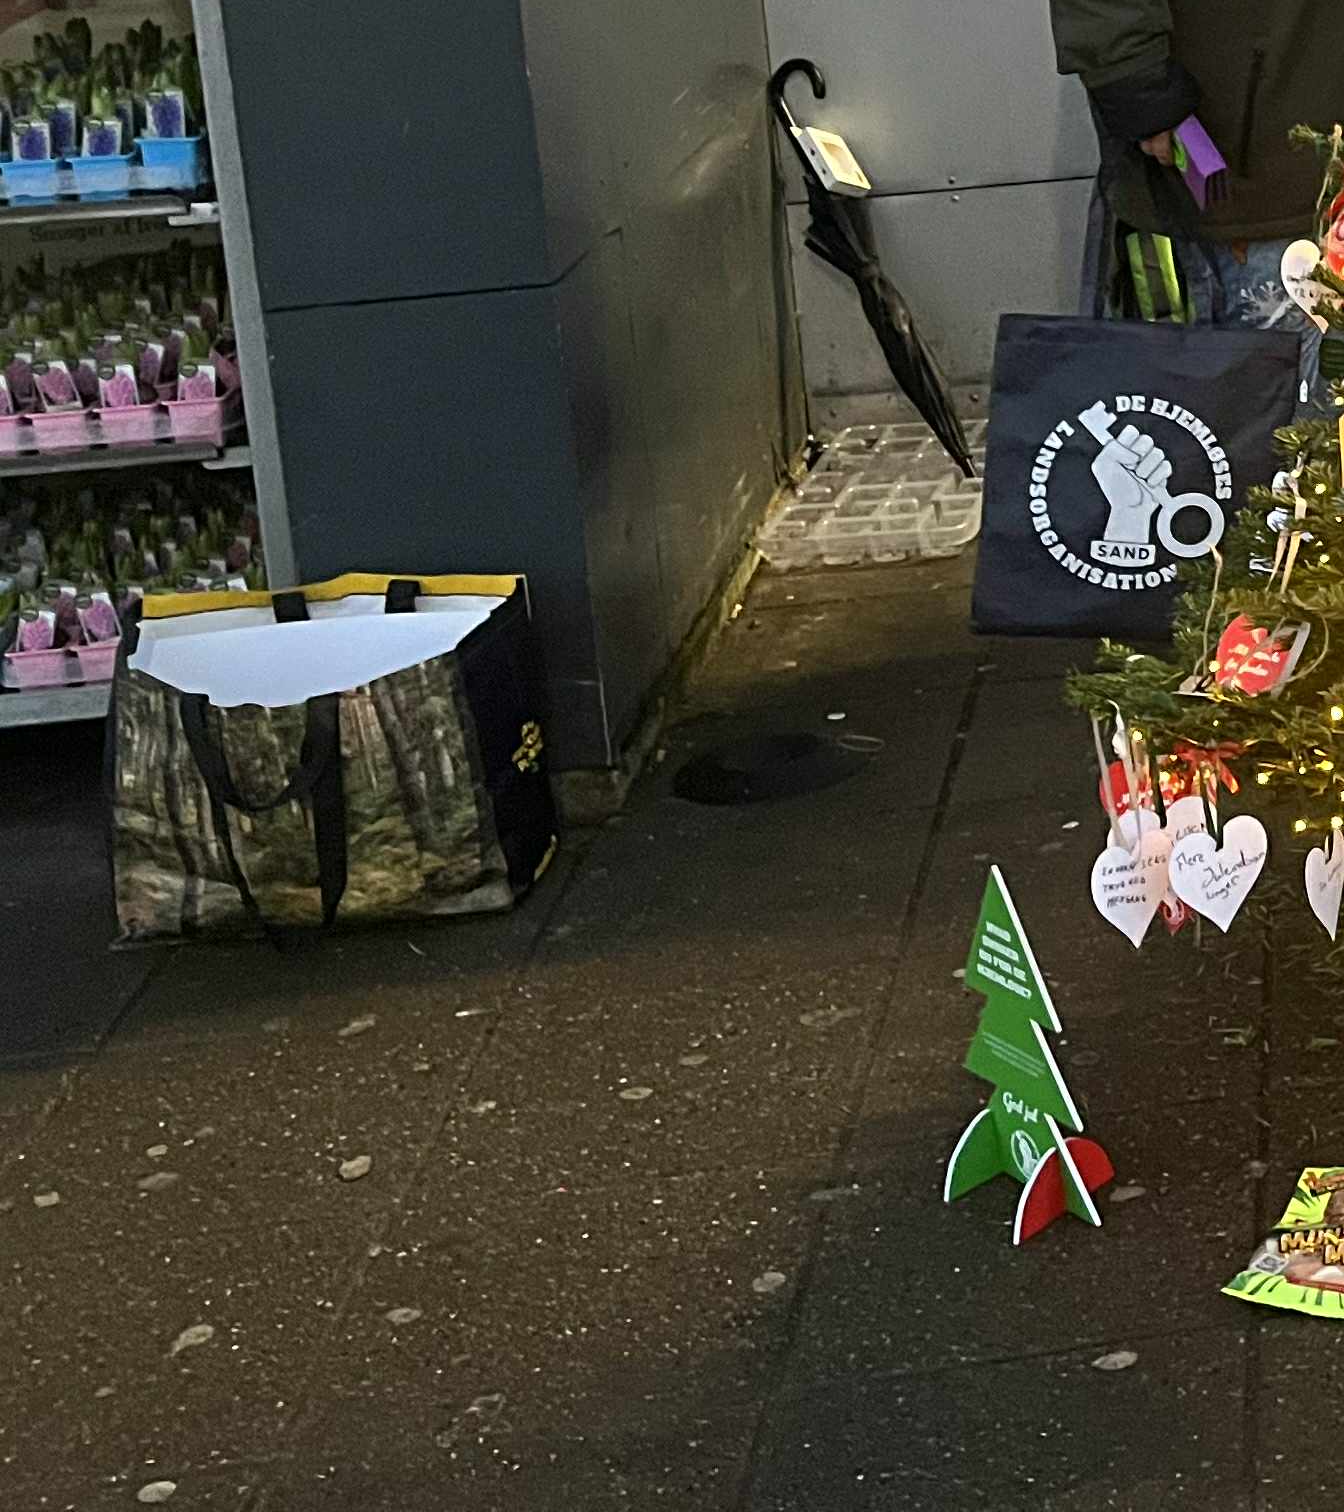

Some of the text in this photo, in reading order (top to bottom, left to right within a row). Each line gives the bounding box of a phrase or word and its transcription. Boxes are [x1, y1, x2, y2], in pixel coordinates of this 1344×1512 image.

[1115, 394, 1146, 412] DE
[1029, 420, 1178, 590] LANDSORGANISATION
[1097, 544, 1150, 561] SAND
